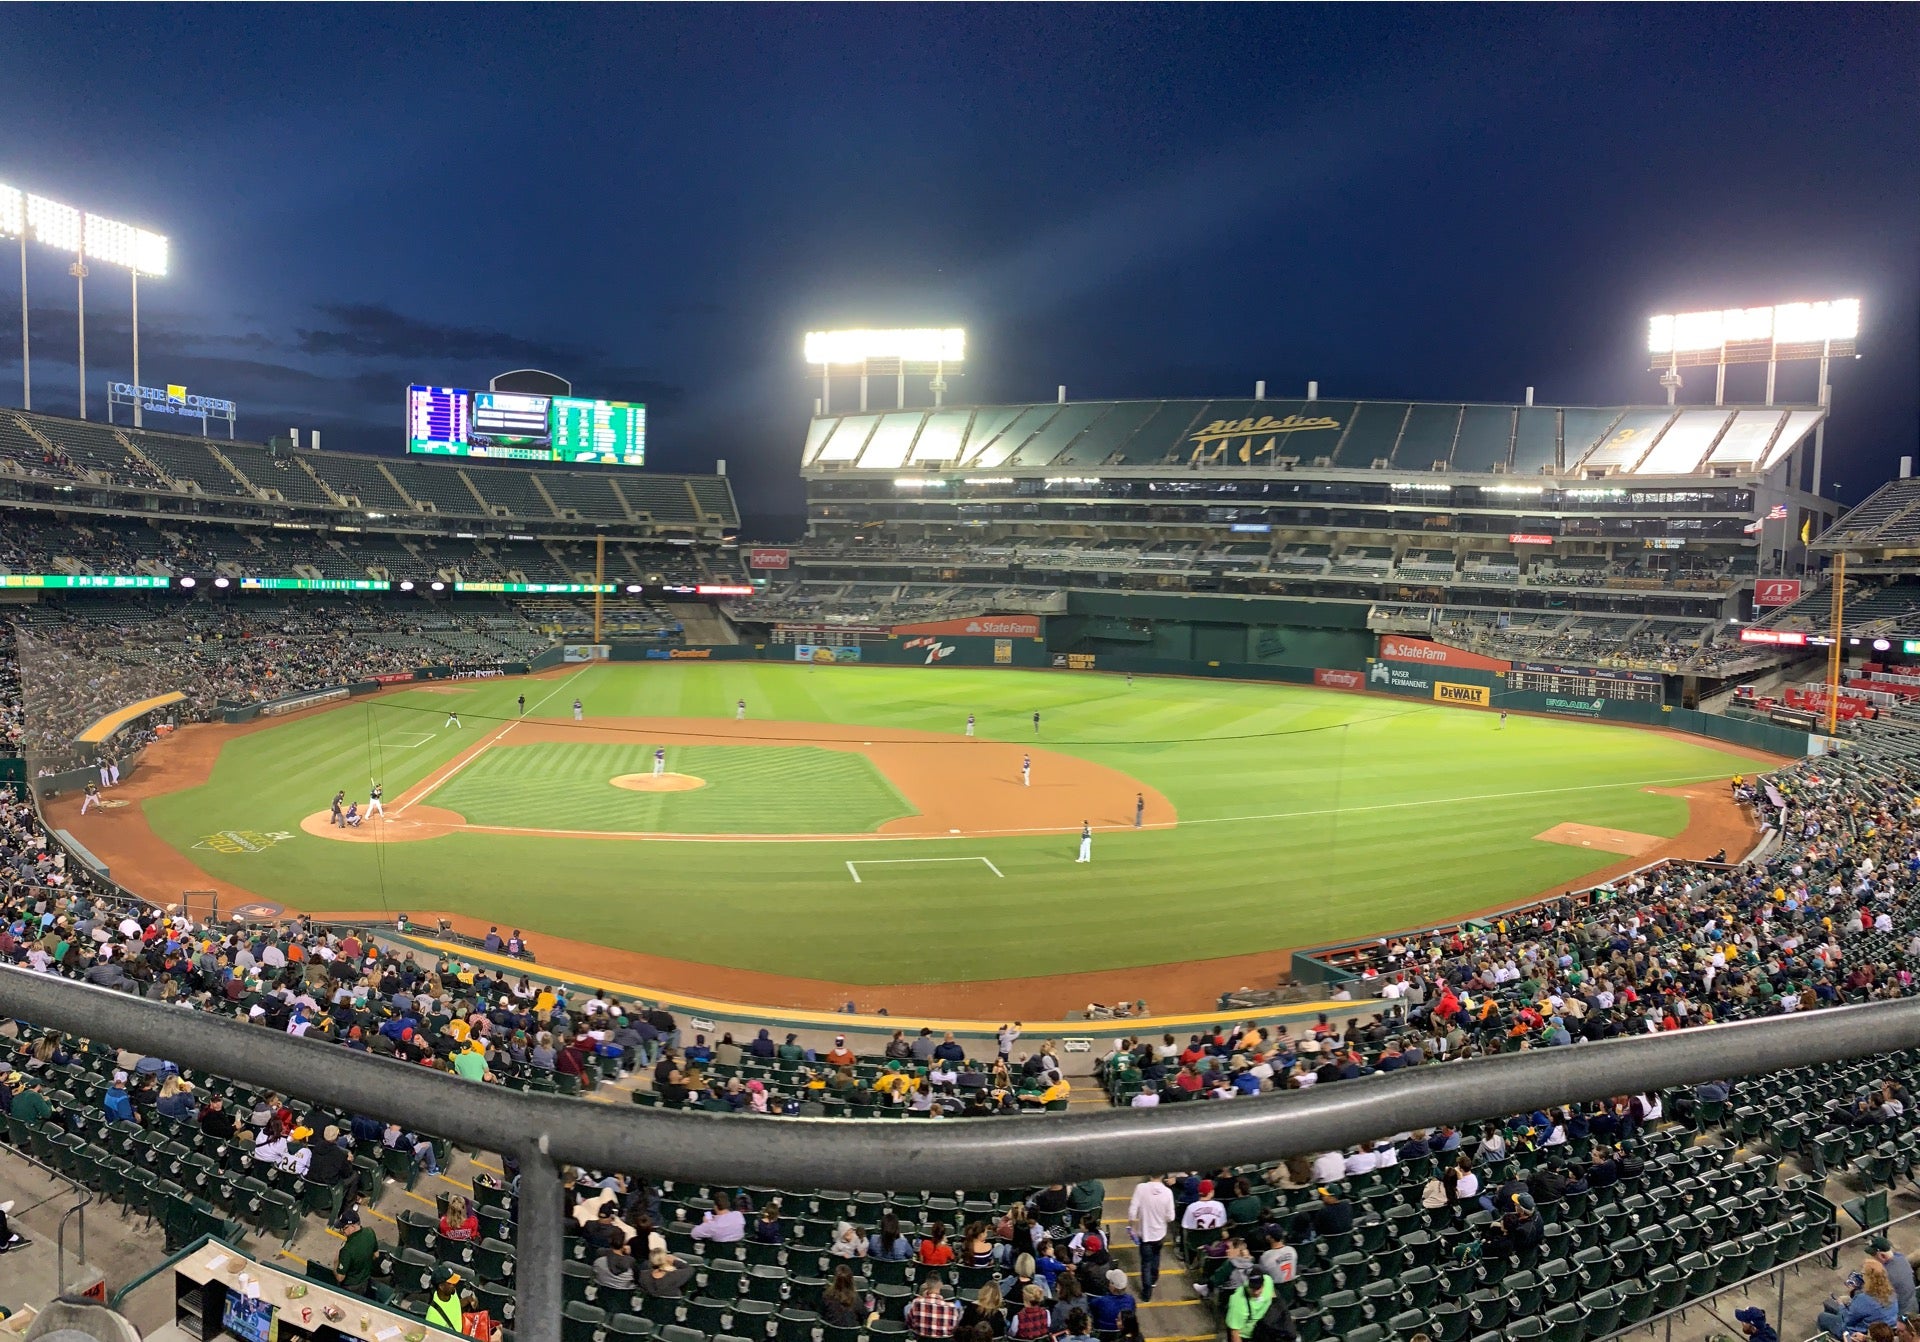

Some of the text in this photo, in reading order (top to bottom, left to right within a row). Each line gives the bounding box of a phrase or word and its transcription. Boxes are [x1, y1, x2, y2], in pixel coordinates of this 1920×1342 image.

[114, 382, 233, 412] CACHE CREEK
[143, 402, 176, 414] CASINO
[1190, 414, 1340, 438] Athletics
[1512, 534, 1551, 544] Budweiser
[754, 553, 787, 565] xfinity
[1321, 670, 1359, 688] xfinity
[1391, 670, 1409, 678] KAISER
[281, 1156, 297, 1173] 24
[1280, 1262, 1293, 1281] 7
